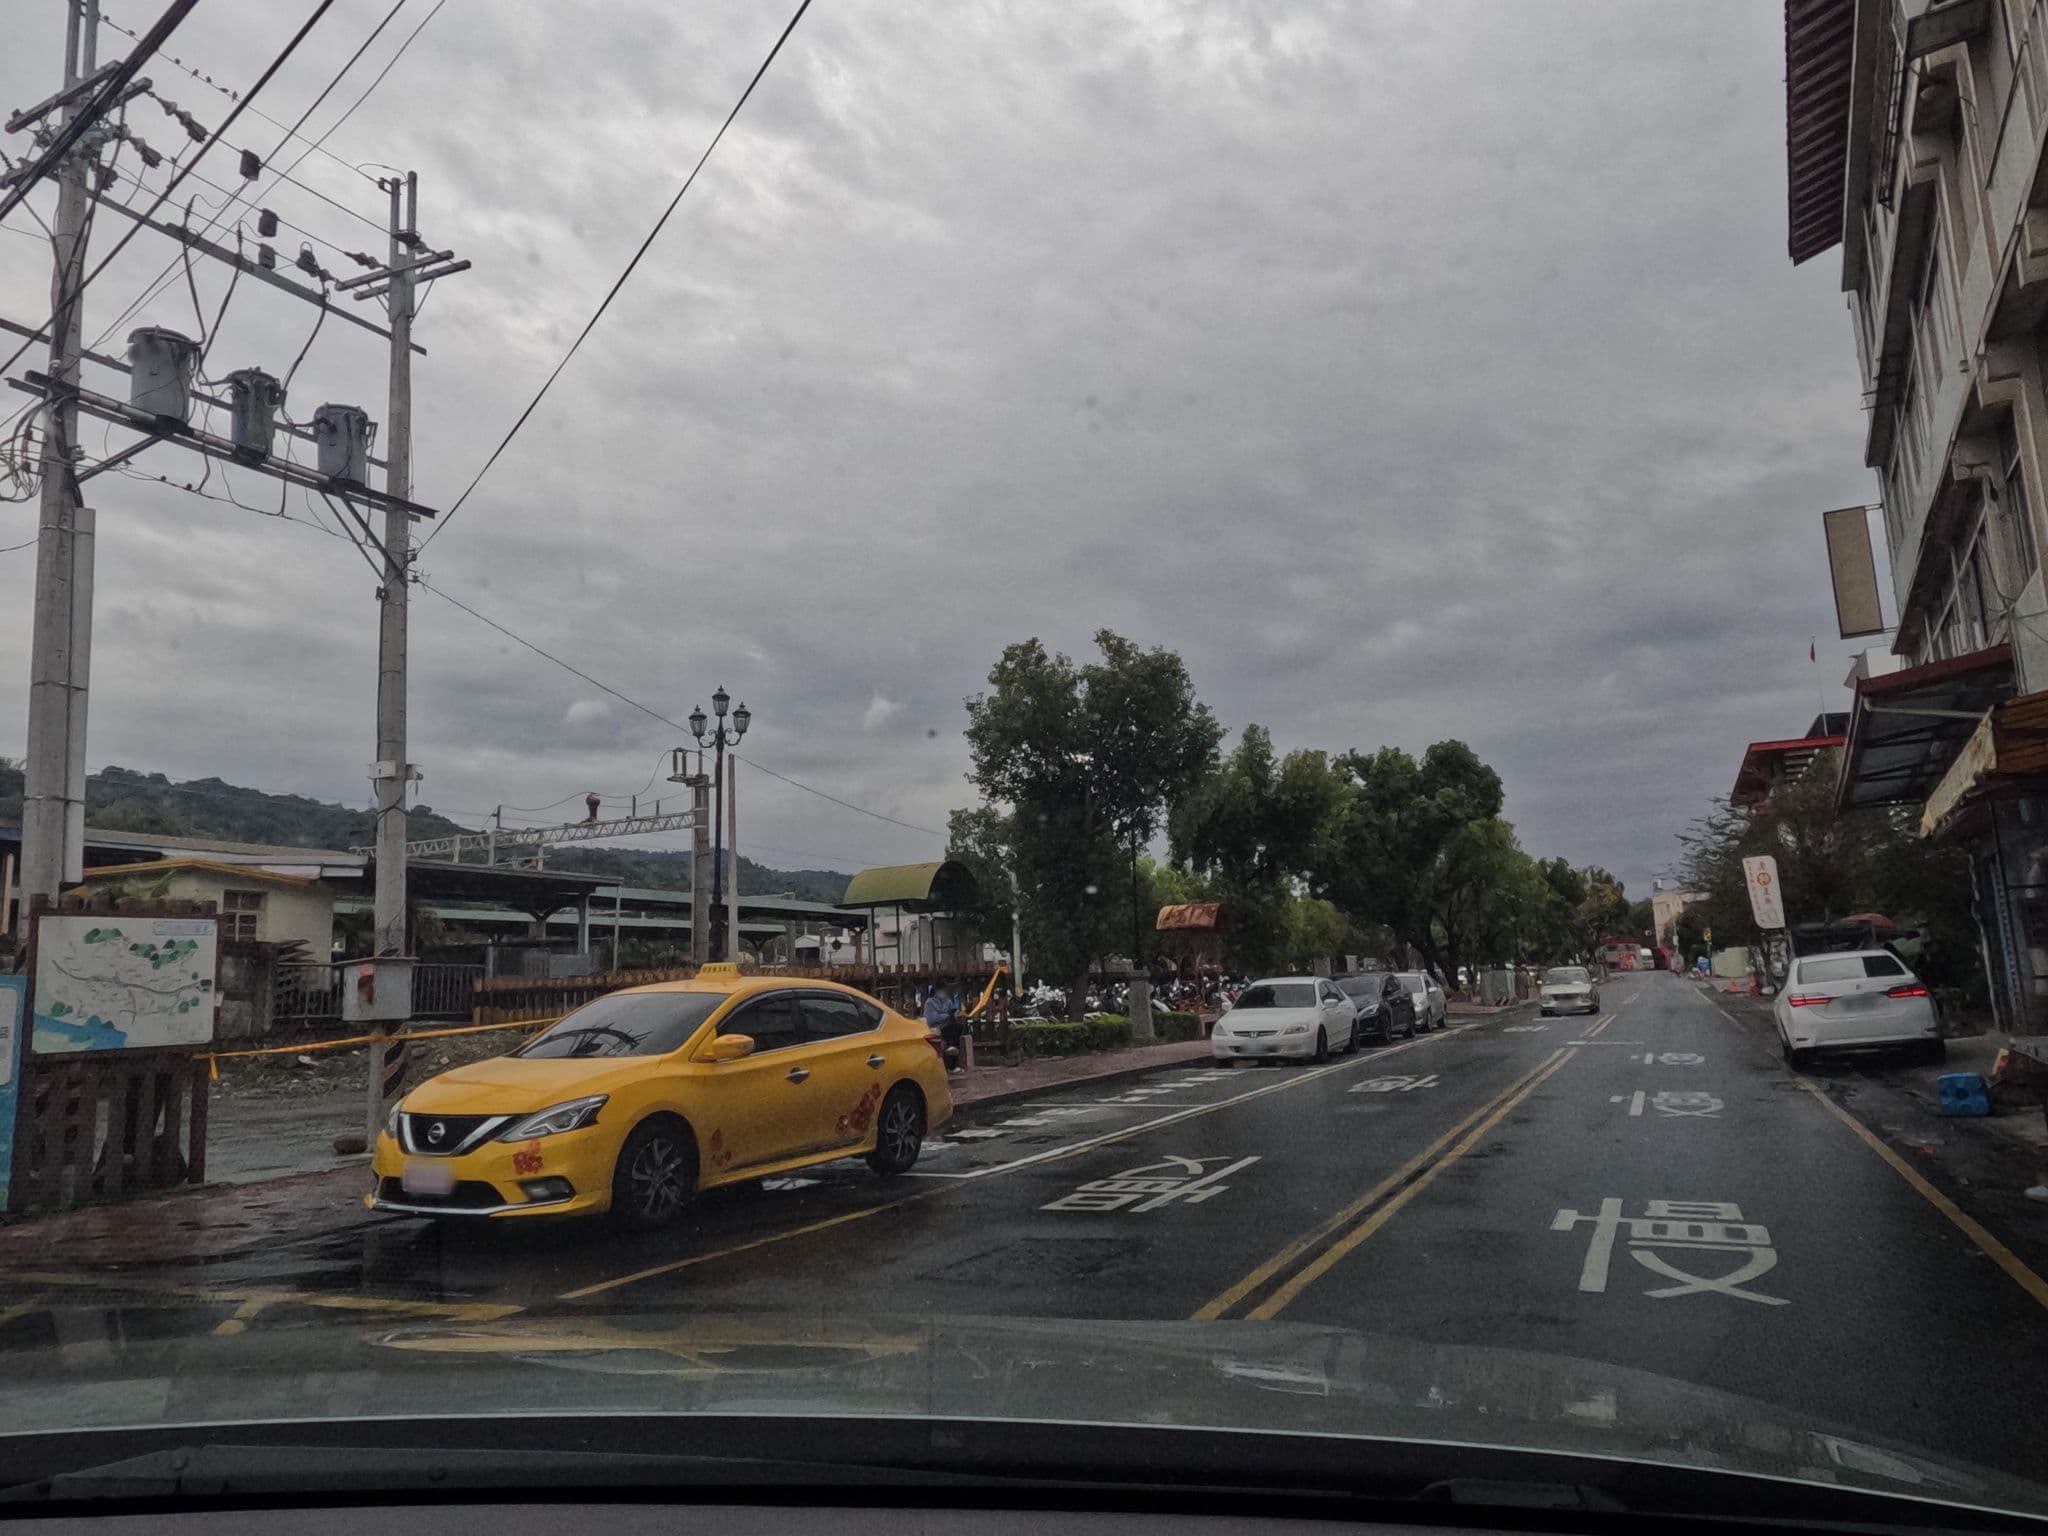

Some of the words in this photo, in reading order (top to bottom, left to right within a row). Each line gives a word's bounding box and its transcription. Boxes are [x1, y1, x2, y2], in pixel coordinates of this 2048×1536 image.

[1609, 1091, 1724, 1118] 慢
[1039, 1155, 1263, 1213] 慢
[1550, 1197, 1791, 1305] 慢
